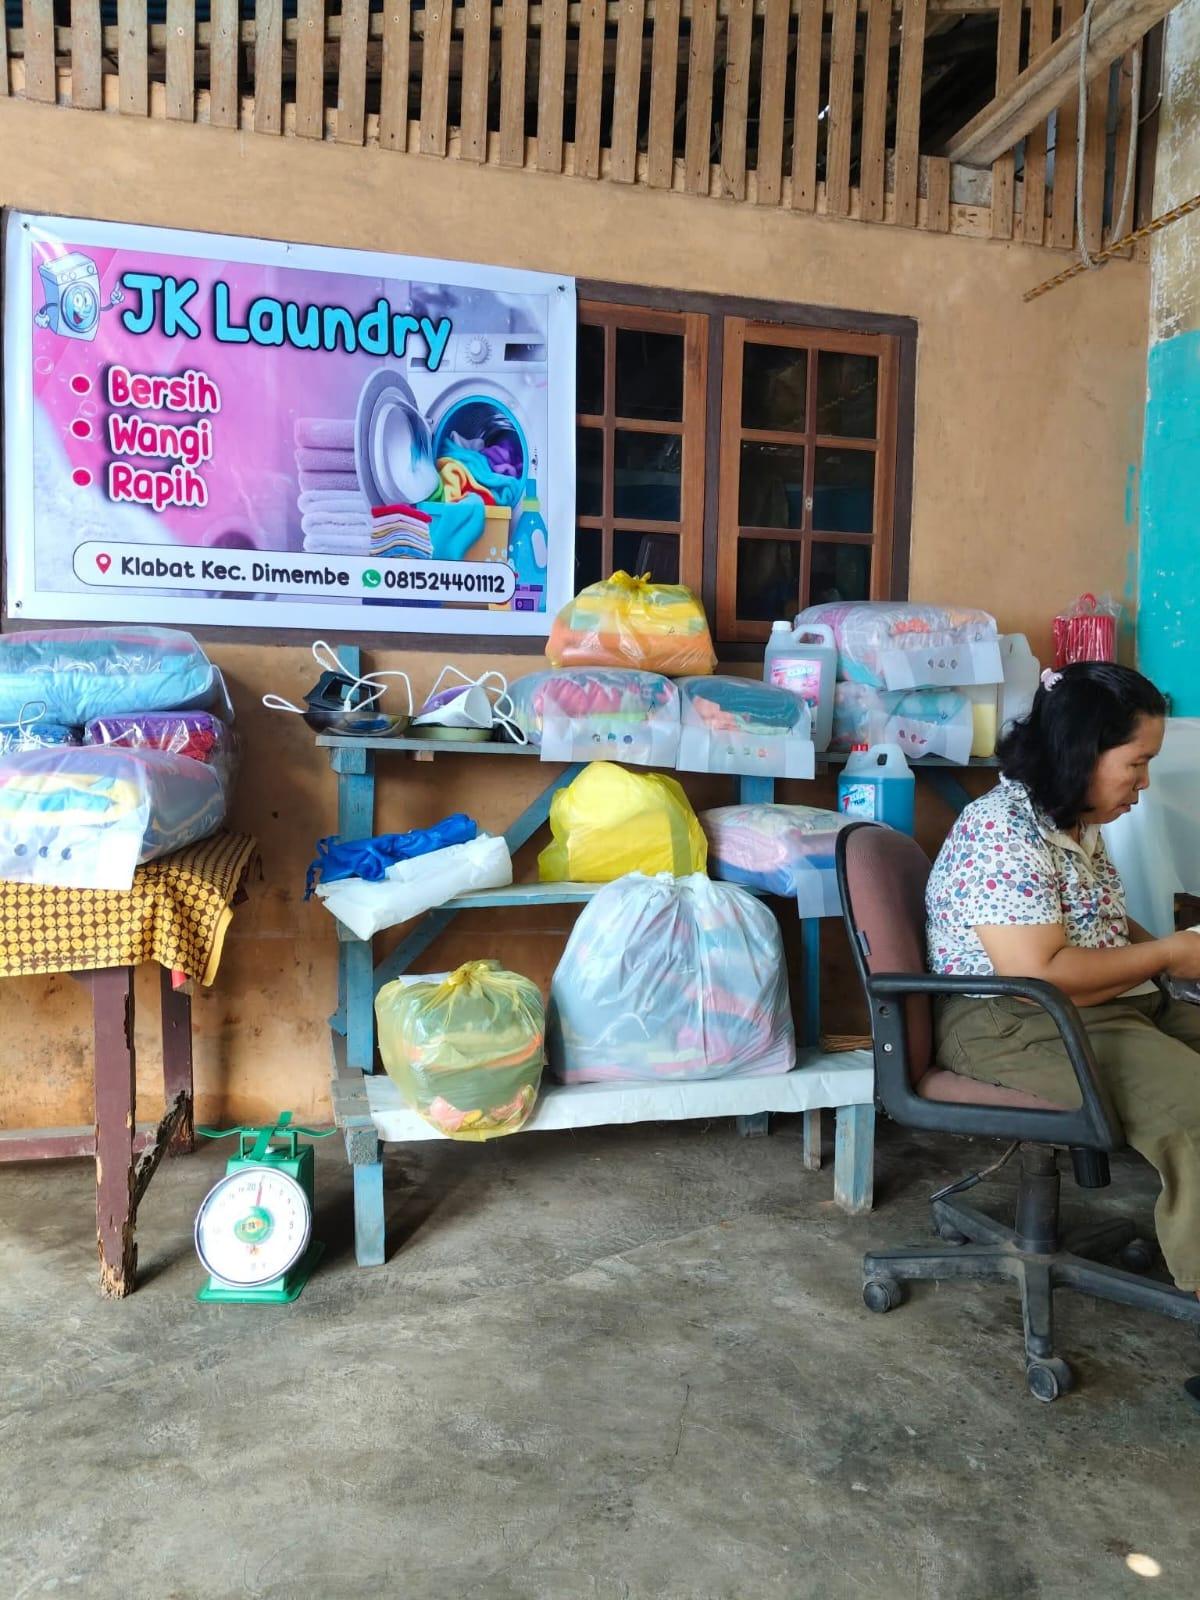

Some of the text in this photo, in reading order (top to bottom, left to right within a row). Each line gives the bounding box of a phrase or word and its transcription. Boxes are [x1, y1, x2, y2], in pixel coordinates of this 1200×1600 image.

[122, 272, 452, 372] JK Laundry
[110, 368, 219, 411] Bersih
[111, 416, 210, 466] Wangi
[111, 463, 206, 510] Rapih
[121, 556, 505, 593] Klabat Kec. Dimembe 081524401112
